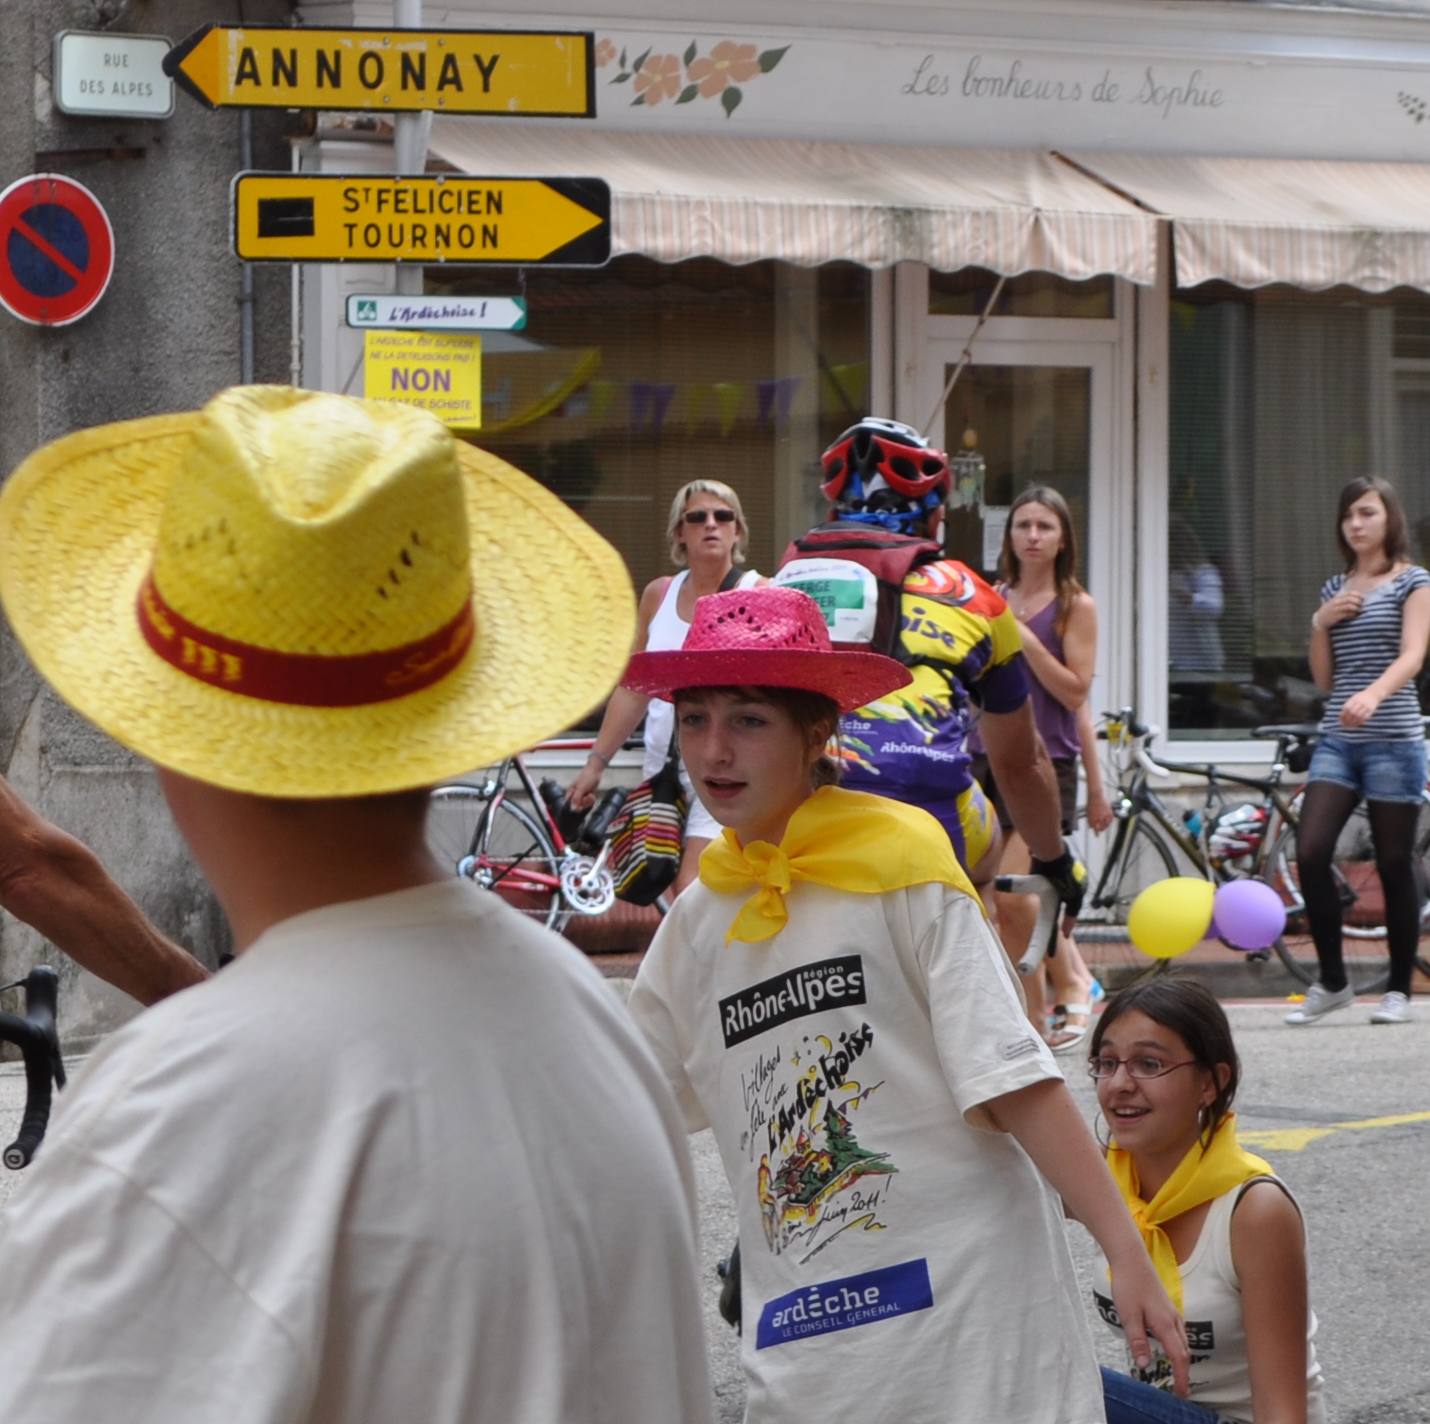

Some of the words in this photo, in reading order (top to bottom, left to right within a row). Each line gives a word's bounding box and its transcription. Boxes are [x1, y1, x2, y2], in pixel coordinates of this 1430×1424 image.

[103, 53, 129, 68] RUE
[233, 46, 502, 93] ANNONAY
[79, 79, 105, 94] DES
[112, 81, 154, 97] ALPES
[901, 54, 949, 97] Les
[961, 54, 1084, 101] bonheurs
[1091, 69, 1121, 103] de
[1130, 66, 1226, 119] Sophie
[376, 188, 504, 216] FELICIEN
[344, 222, 500, 250] TOURNON
[391, 366, 452, 393] NON
[803, 965, 844, 980] Région
[782, 1327, 793, 1338] LE
[794, 1315, 844, 1336] CONSEIL
[846, 1302, 902, 1326] GENERAL
